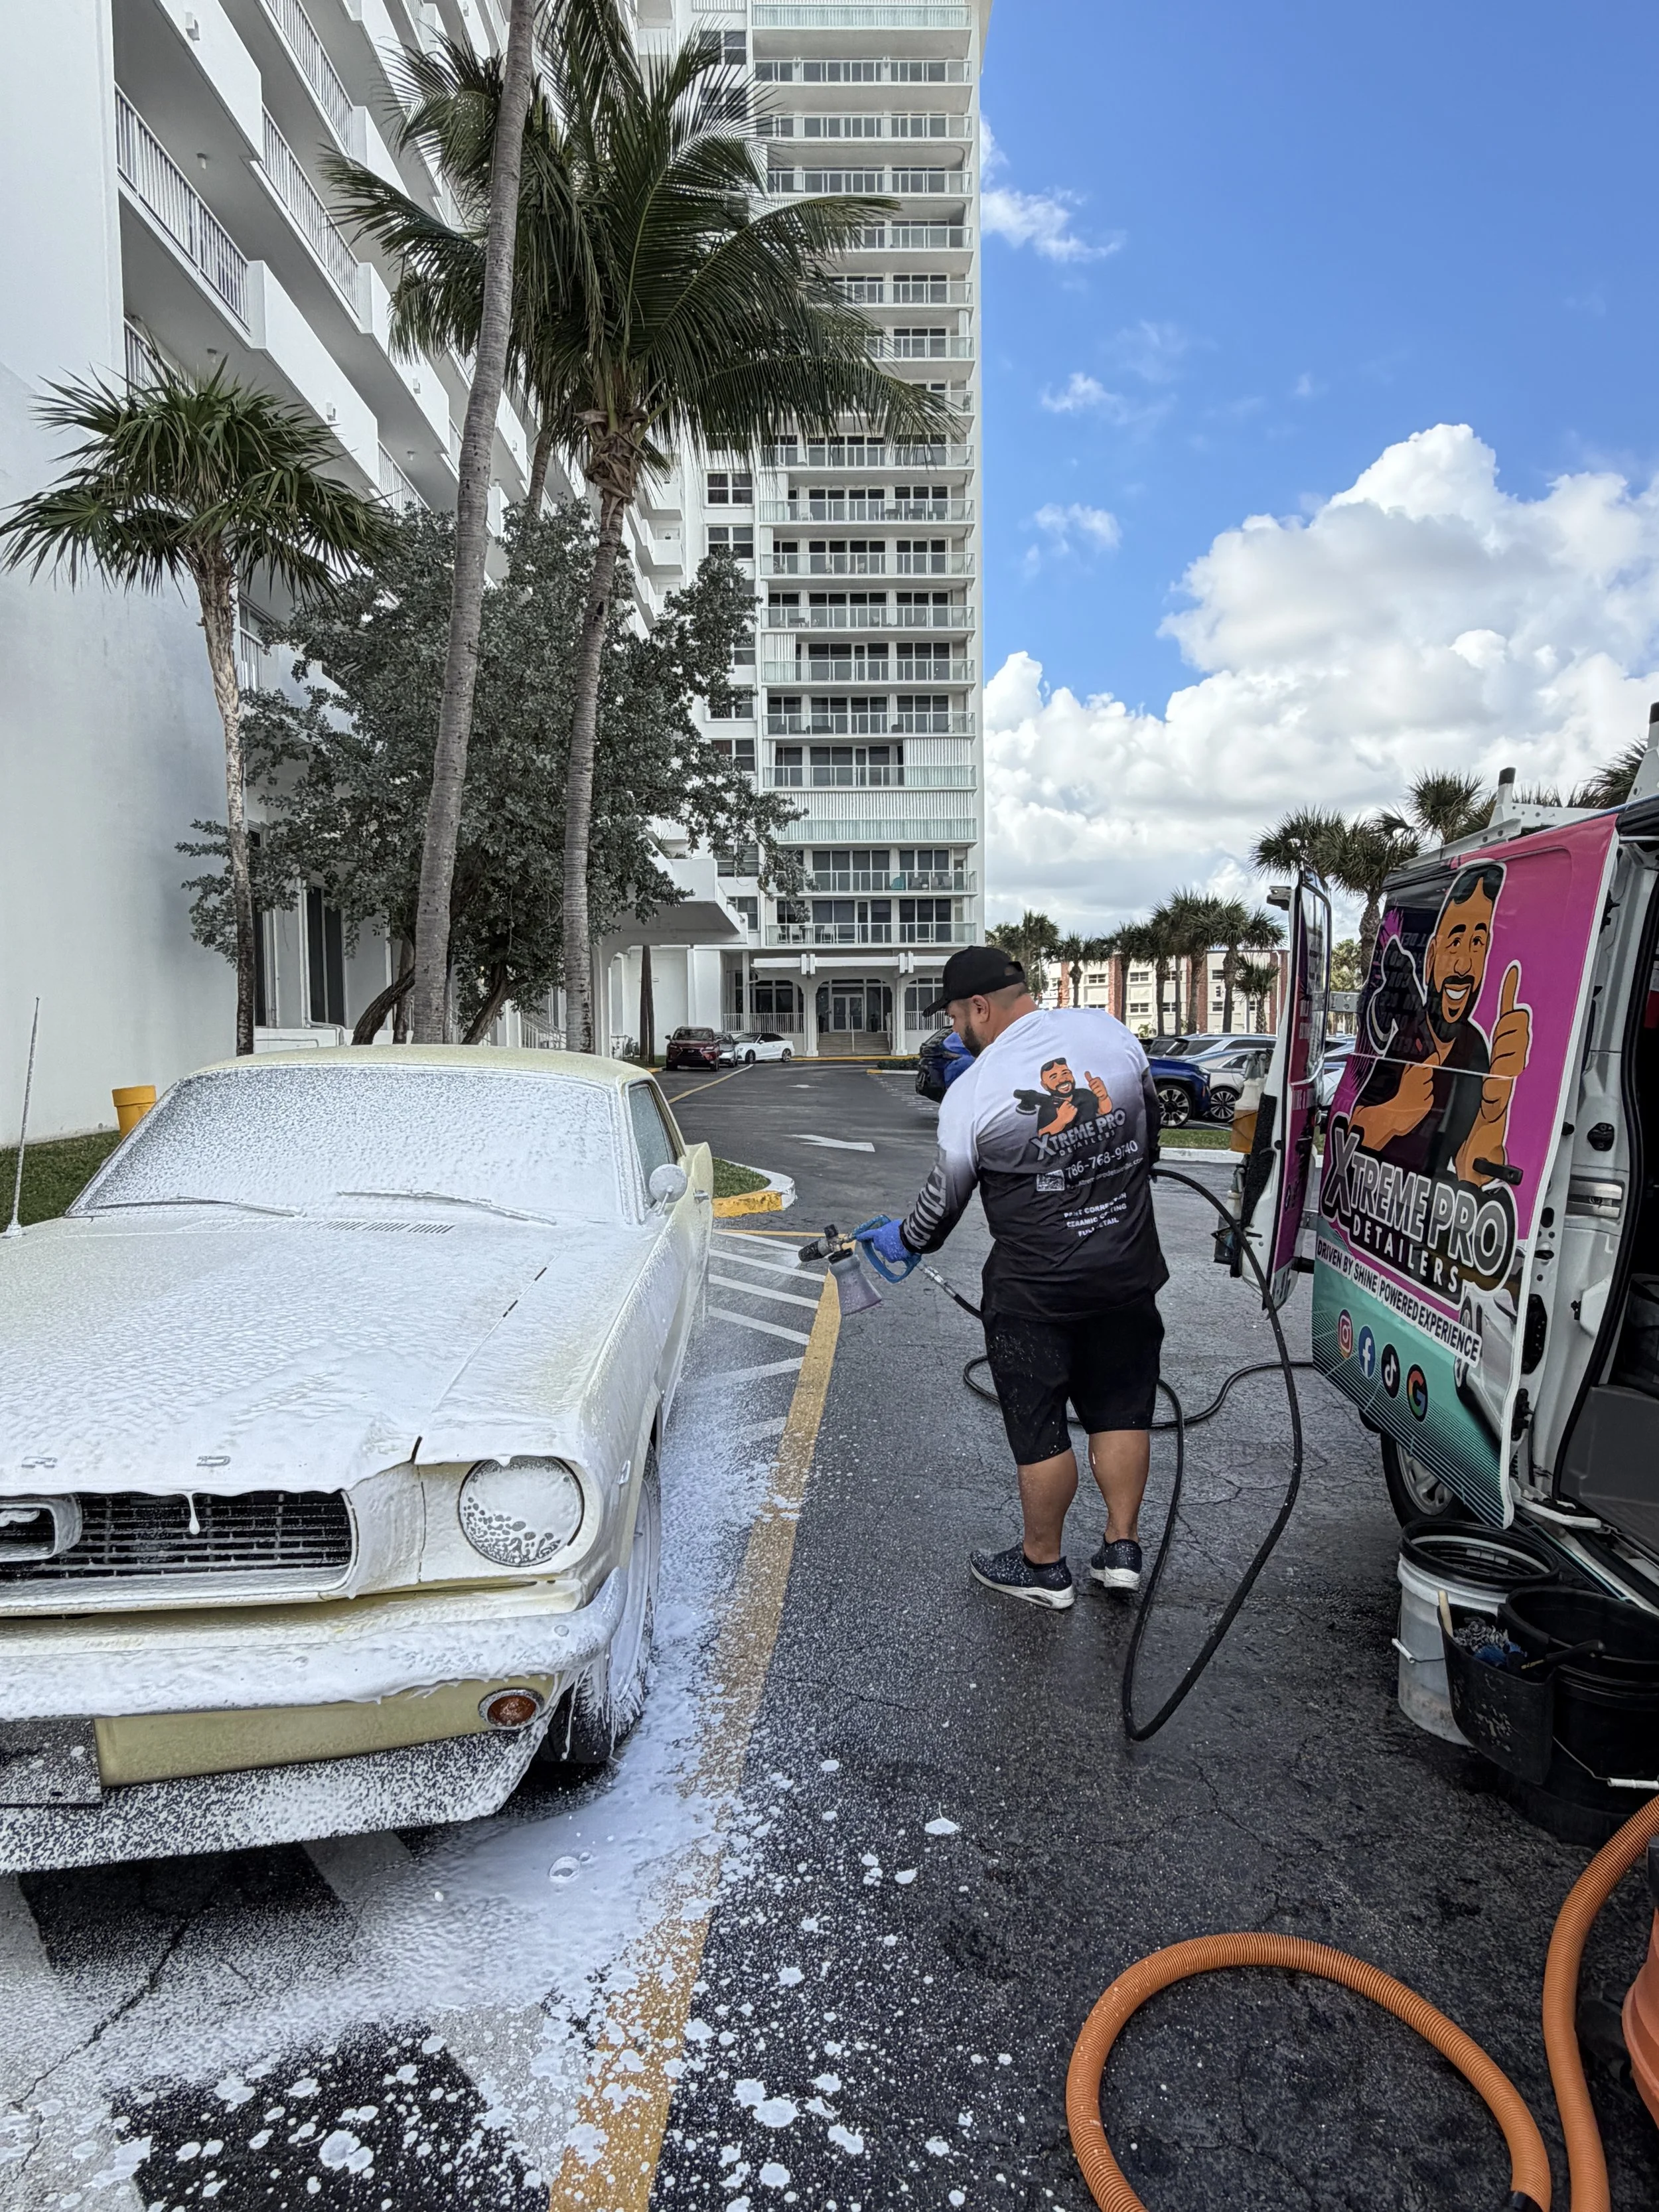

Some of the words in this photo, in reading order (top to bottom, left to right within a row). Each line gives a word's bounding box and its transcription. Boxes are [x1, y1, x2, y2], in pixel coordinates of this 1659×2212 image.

[1031, 1121, 1095, 1160] XTREME
[1096, 1110, 1126, 1134] PRO
[1059, 1130, 1115, 1156] DETAILERS
[1064, 1209, 1082, 1218] PANT
[1084, 1192, 1127, 1214] CORREN
[1100, 1203, 1127, 1219] CTING
[1325, 1128, 1431, 1242] XTREME
[1427, 1182, 1508, 1276] PRO
[1078, 1226, 1095, 1237] FUL
[1096, 1217, 1119, 1229] TAIL
[1353, 1217, 1459, 1293] DETAILERS
[1317, 1241, 1342, 1269] DRIVEN
[1342, 1256, 1353, 1275] BY
[1354, 1264, 1378, 1293] SHINE
[1380, 1278, 1419, 1321] POWERED
[1419, 1306, 1480, 1361] EXPERIENCE
